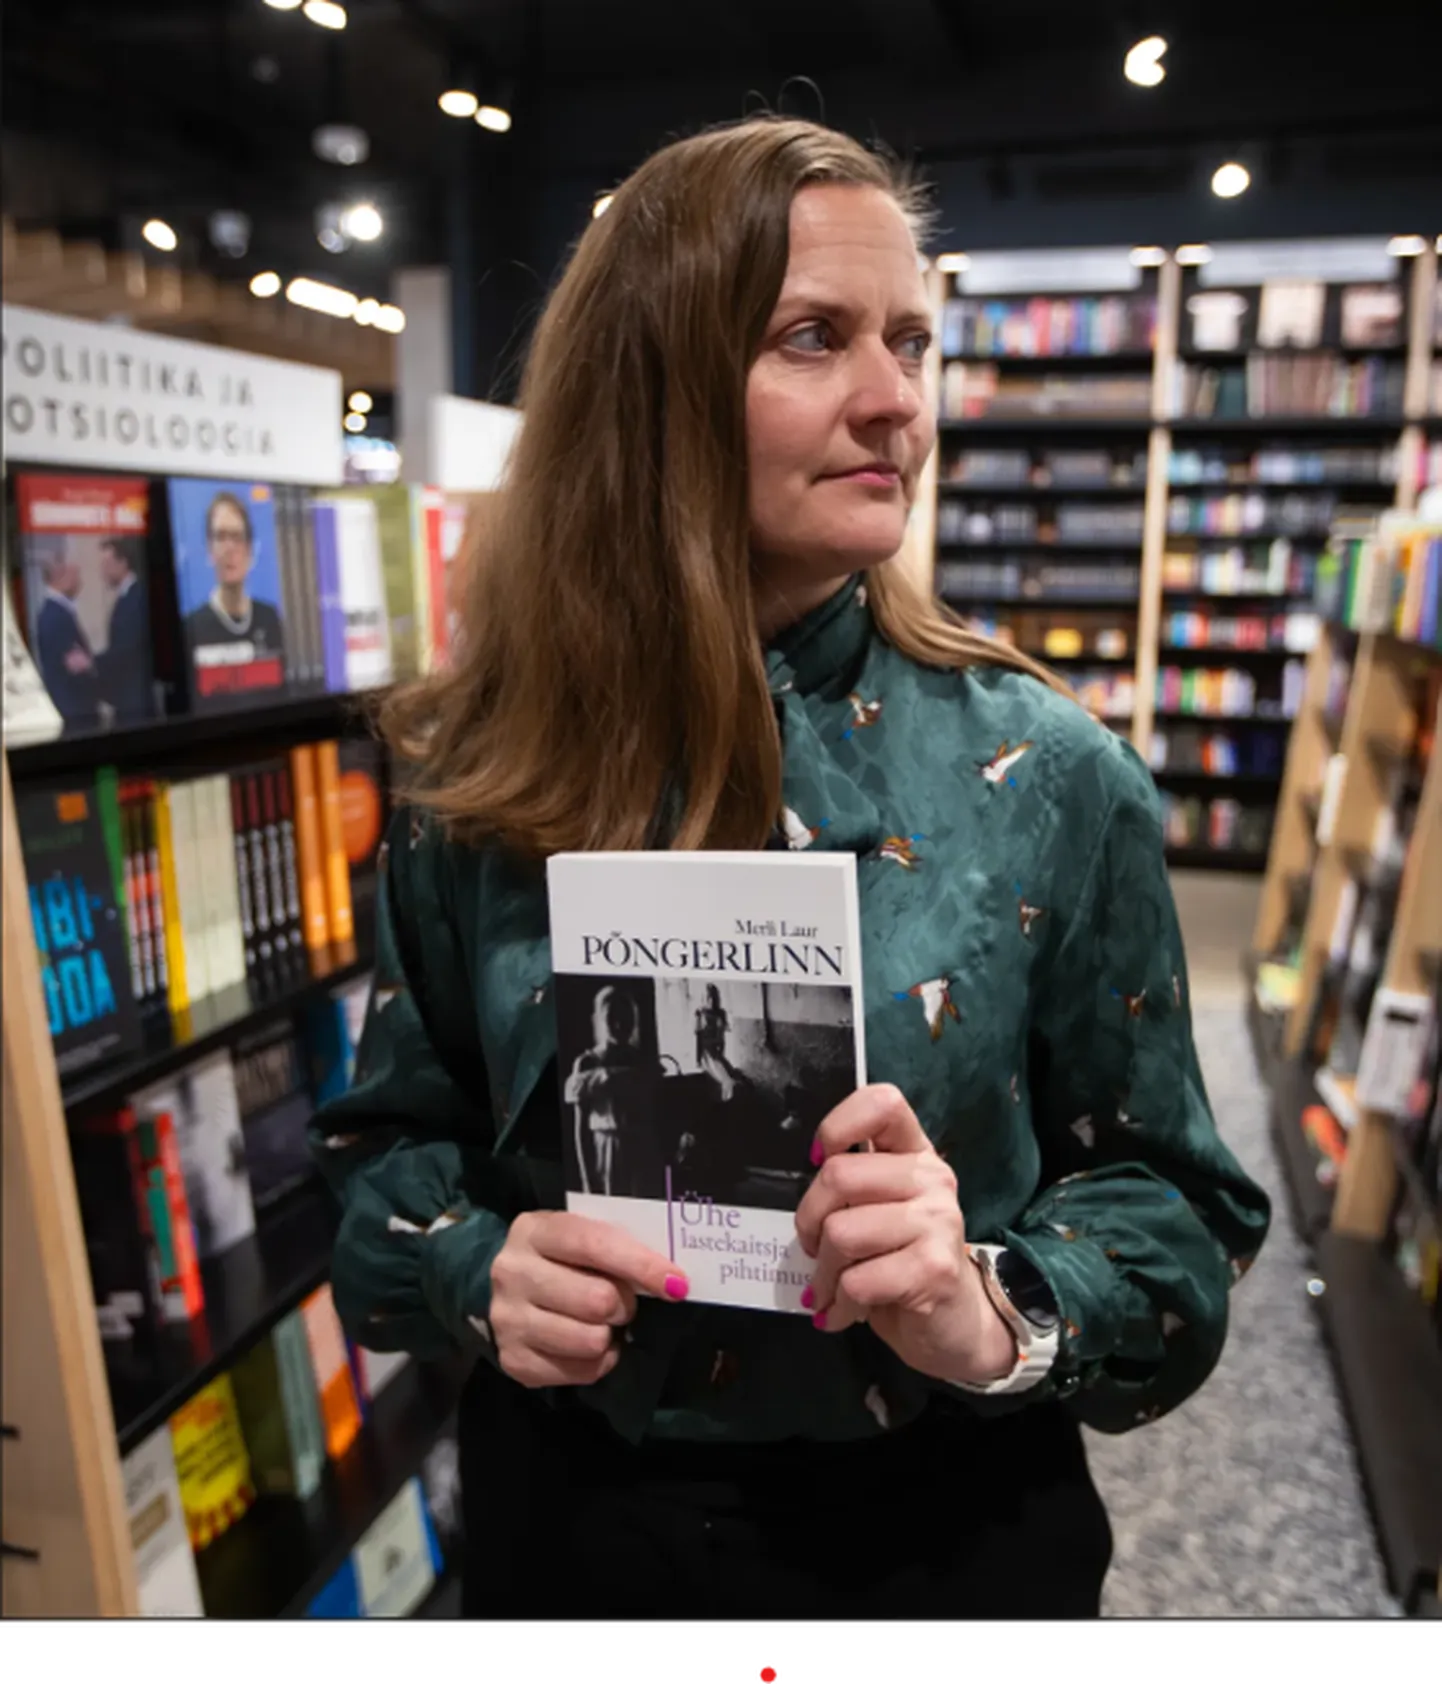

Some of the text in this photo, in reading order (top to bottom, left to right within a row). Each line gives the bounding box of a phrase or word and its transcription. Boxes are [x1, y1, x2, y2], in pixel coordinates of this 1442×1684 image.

[0, 334, 205, 399] OLIITIKA
[780, 920, 819, 938] Laur
[581, 931, 843, 976] PÕNGERLINN
[679, 1190, 742, 1229] Ühe
[680, 1227, 791, 1263] lastekaitsja
[719, 1257, 813, 1285] pihtimus
